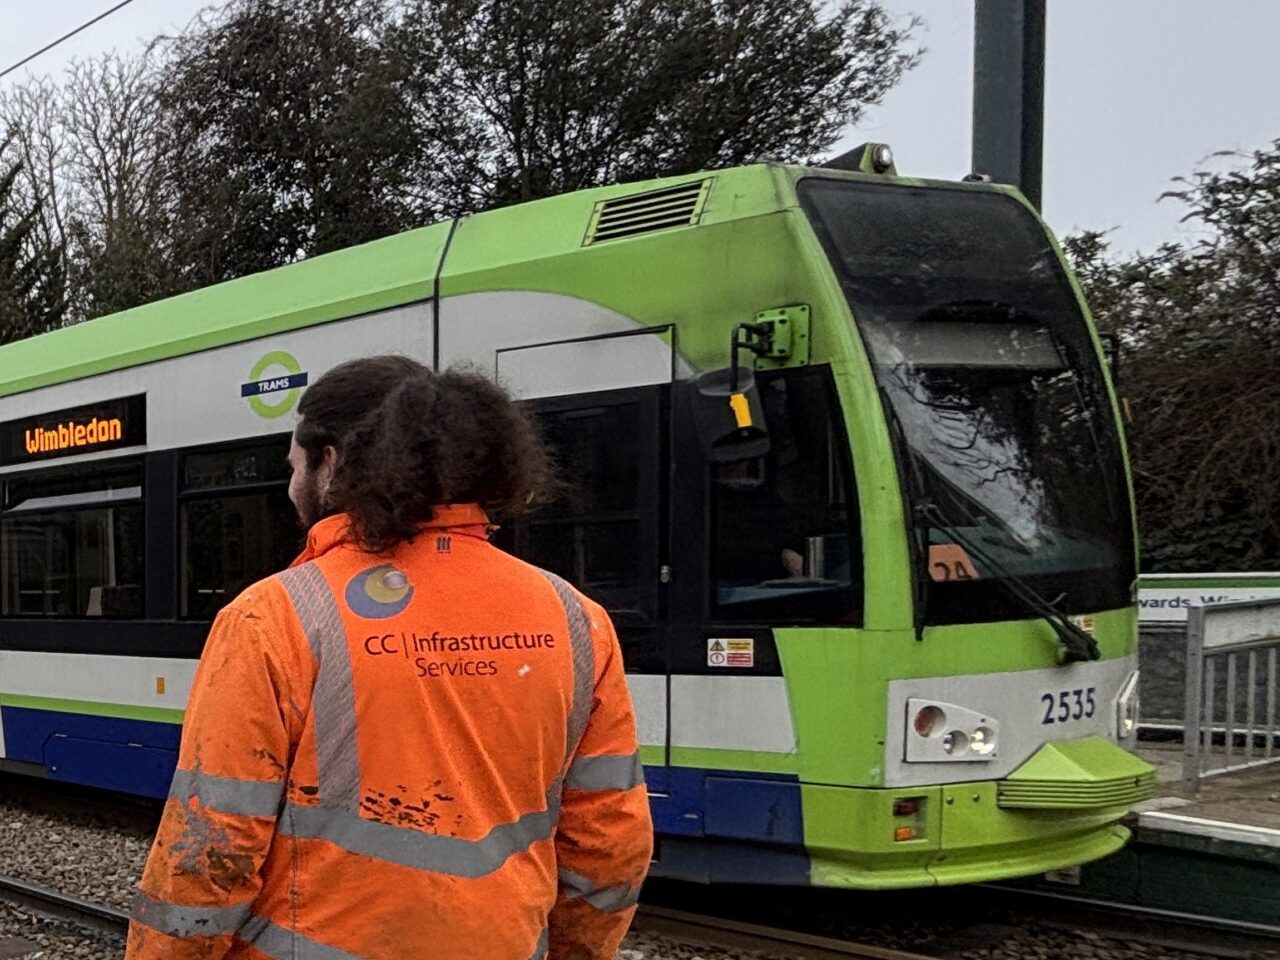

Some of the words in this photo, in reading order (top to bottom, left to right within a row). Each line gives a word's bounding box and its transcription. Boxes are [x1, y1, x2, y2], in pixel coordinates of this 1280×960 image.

[258, 378, 289, 392] TRAMS
[25, 417, 122, 454] Wimbledon
[364, 634, 398, 656] CC
[412, 631, 555, 653] Infrastructure
[415, 656, 498, 678] Services
[1041, 687, 1096, 725] 2535
